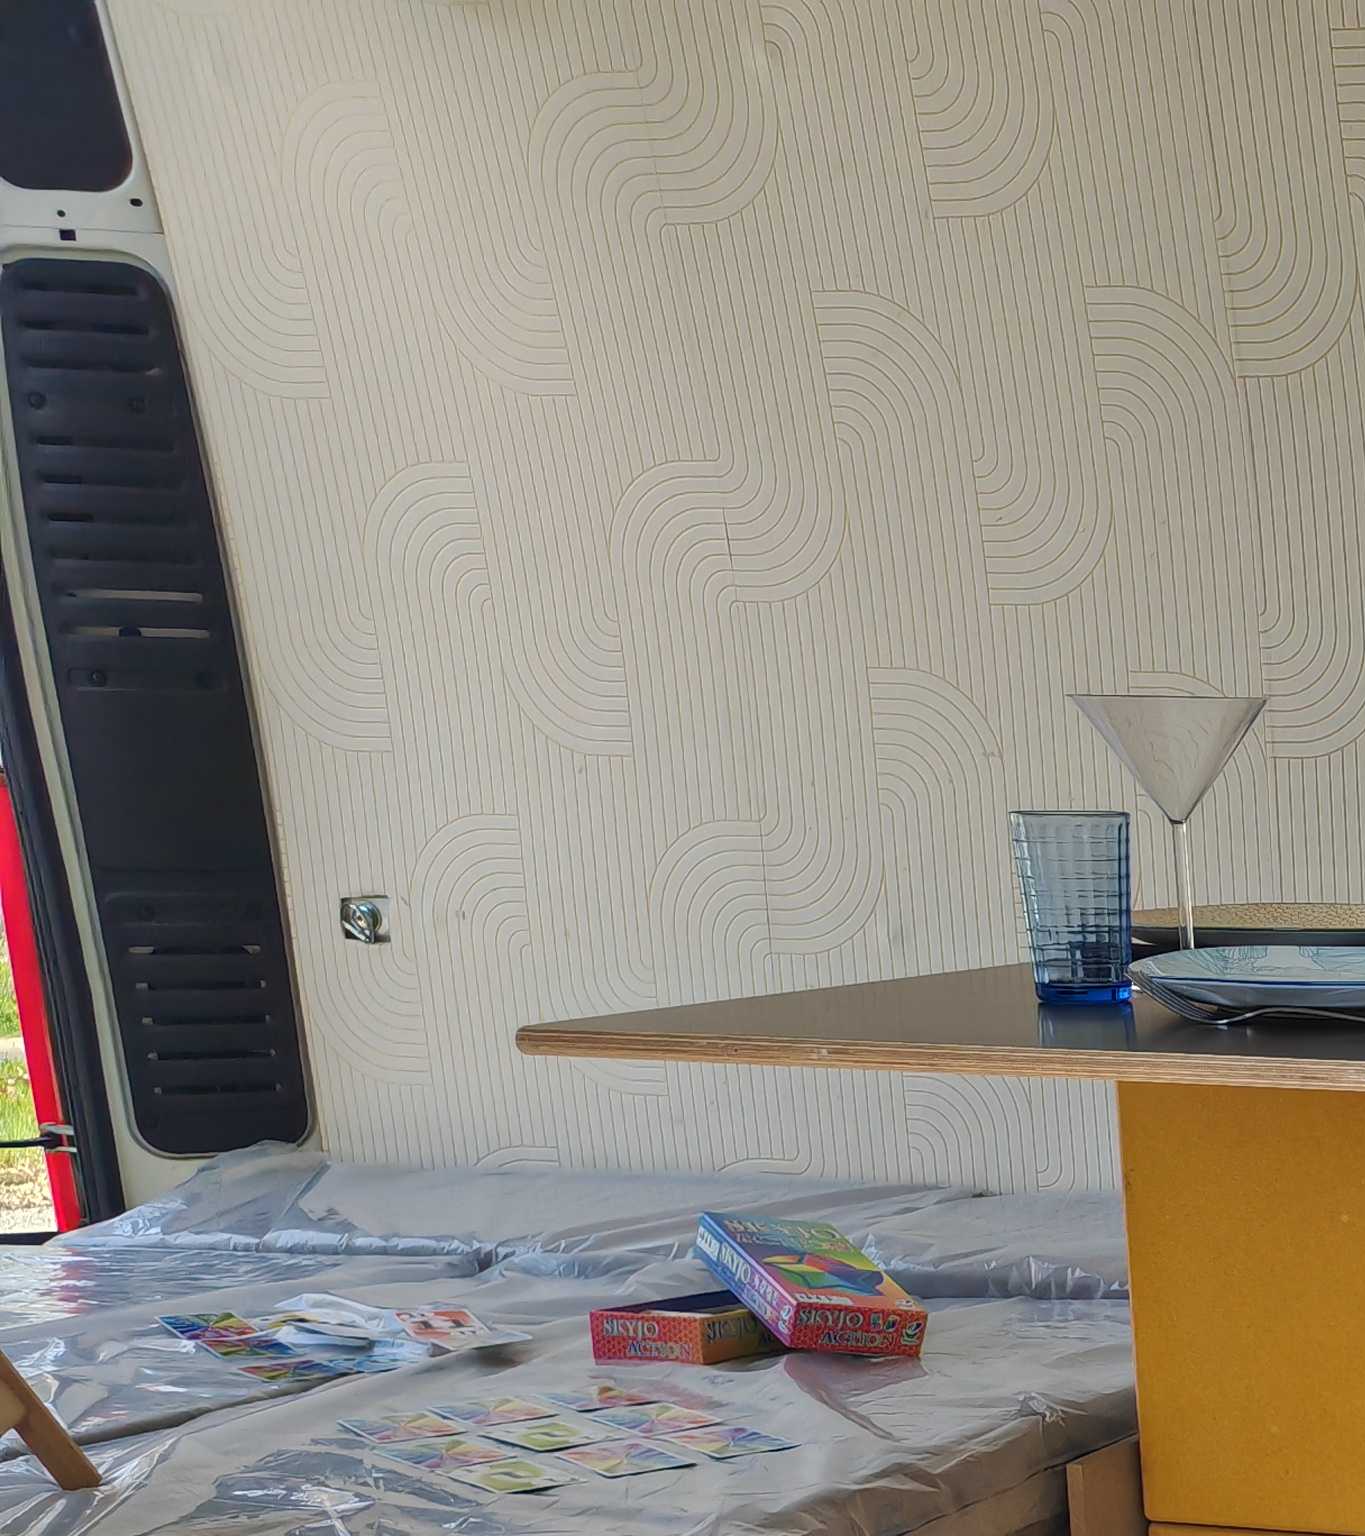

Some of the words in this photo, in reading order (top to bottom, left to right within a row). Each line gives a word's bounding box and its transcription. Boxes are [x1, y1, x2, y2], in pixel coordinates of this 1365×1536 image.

[603, 1318, 659, 1338] SKYJO
[798, 1308, 864, 1331] SKYJO
[819, 1330, 897, 1346] ACTION
[627, 1340, 693, 1361] ACTION
